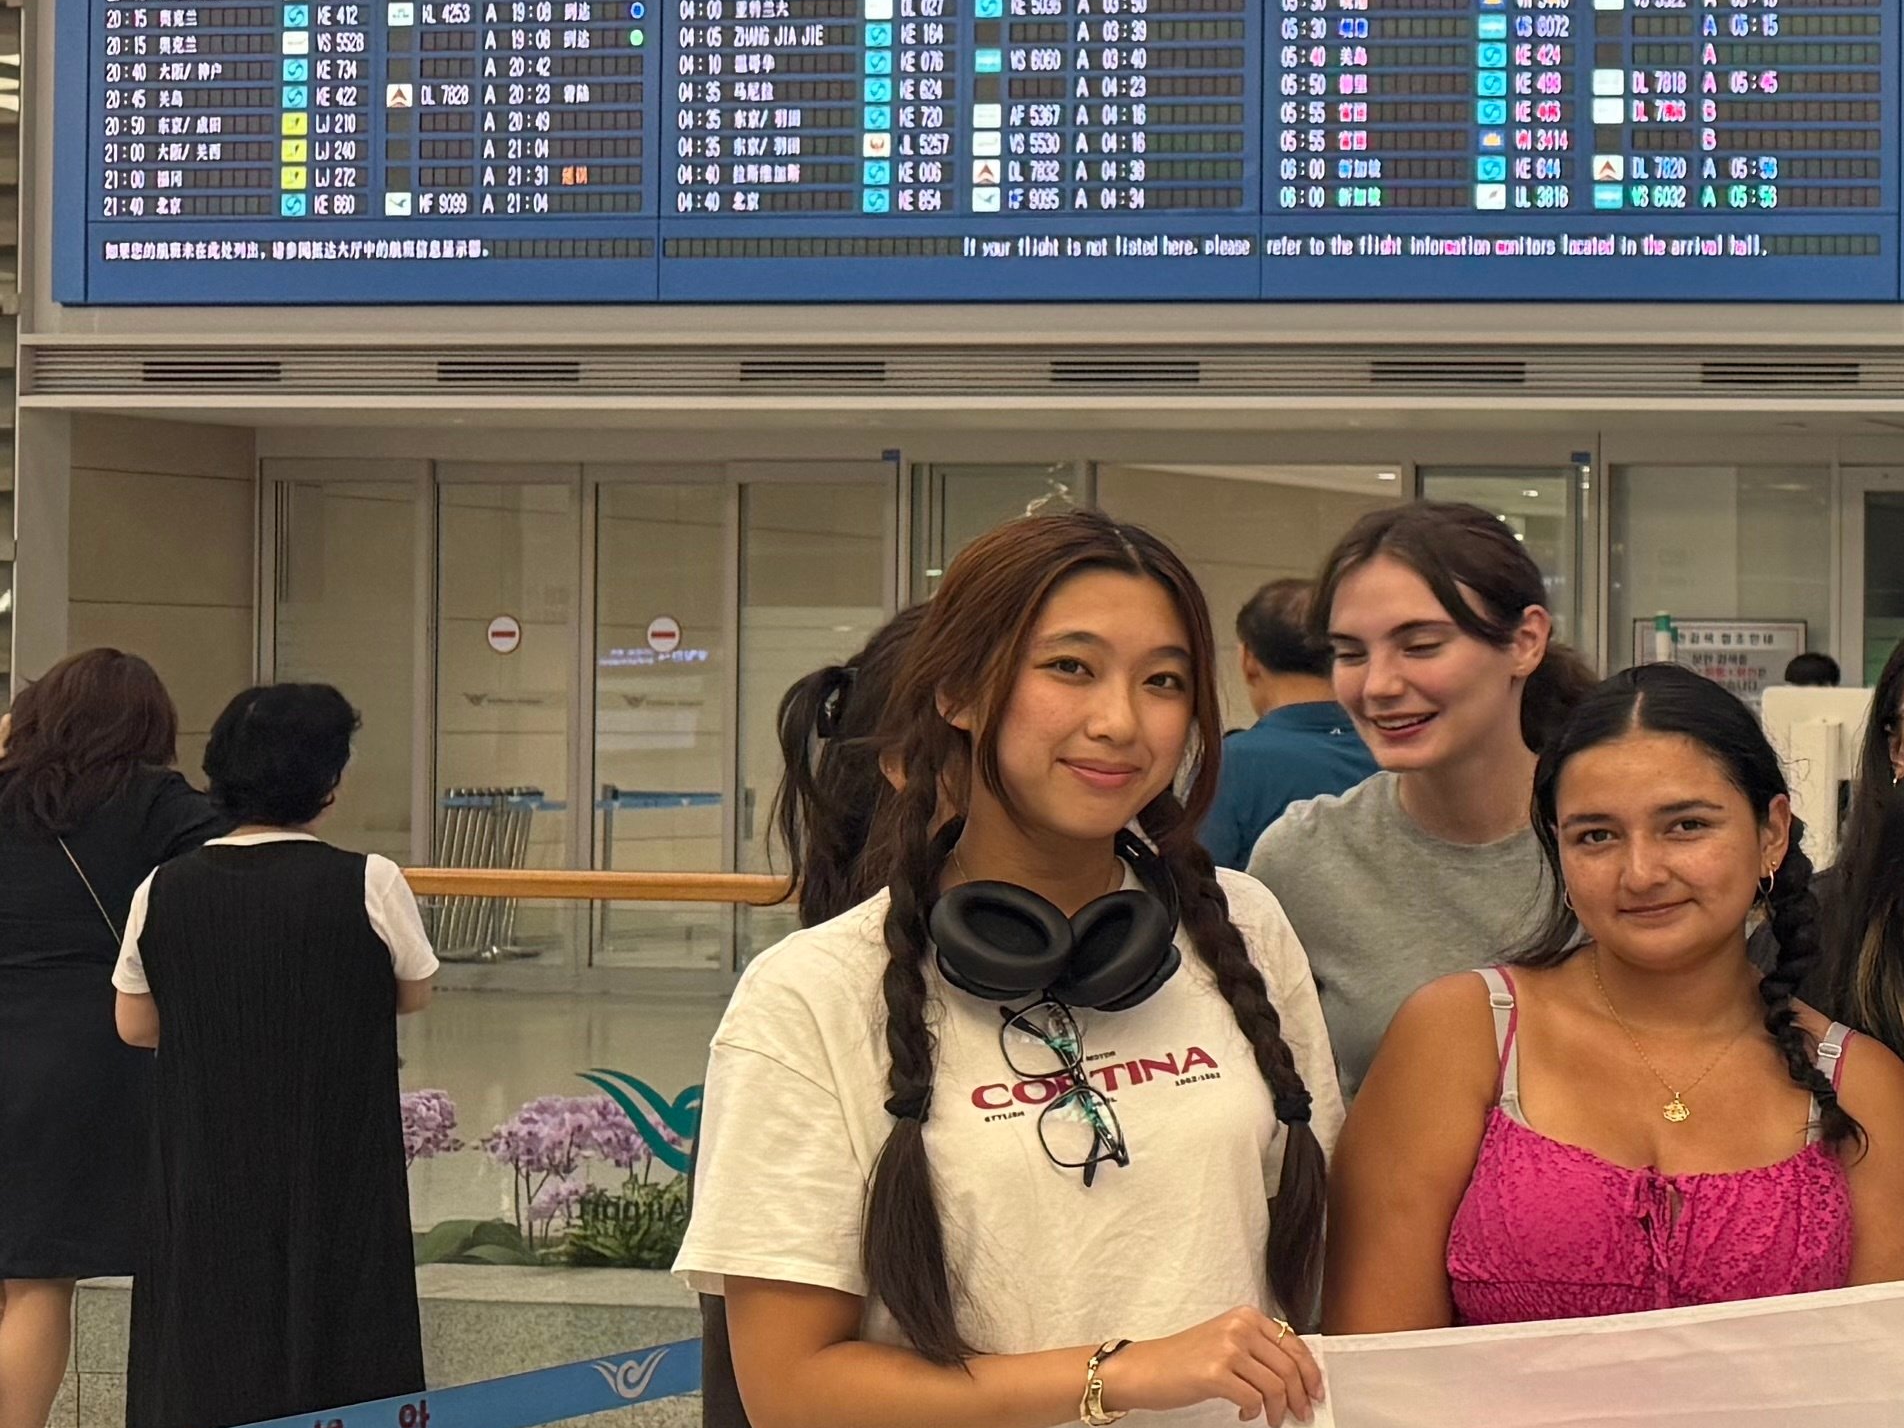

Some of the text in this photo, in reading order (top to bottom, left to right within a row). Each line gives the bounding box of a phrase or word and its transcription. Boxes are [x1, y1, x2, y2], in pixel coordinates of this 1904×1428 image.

[680, 26, 721, 47] 04:05
[774, 26, 796, 46] JIA
[802, 25, 823, 45] JIE
[1281, 46, 1325, 67] 05:40
[107, 84, 550, 109] 20:45 KE 422 A 20:23
[105, 170, 144, 189] 21:00
[316, 169, 329, 187] LJ
[335, 167, 355, 187] 272
[484, 167, 494, 186] A
[508, 165, 548, 186] 21:31
[678, 164, 719, 184] 04:40
[1280, 186, 1324, 208] 06:00
[983, 242, 1010, 256] your
[1086, 239, 1107, 256] not
[1205, 234, 1250, 255] please
[1267, 236, 1301, 255] refer
[1310, 238, 1324, 255] to
[1331, 235, 1353, 255] the
[1360, 234, 1401, 255] flight
[1621, 237, 1636, 255] in
[1642, 235, 1666, 255] the
